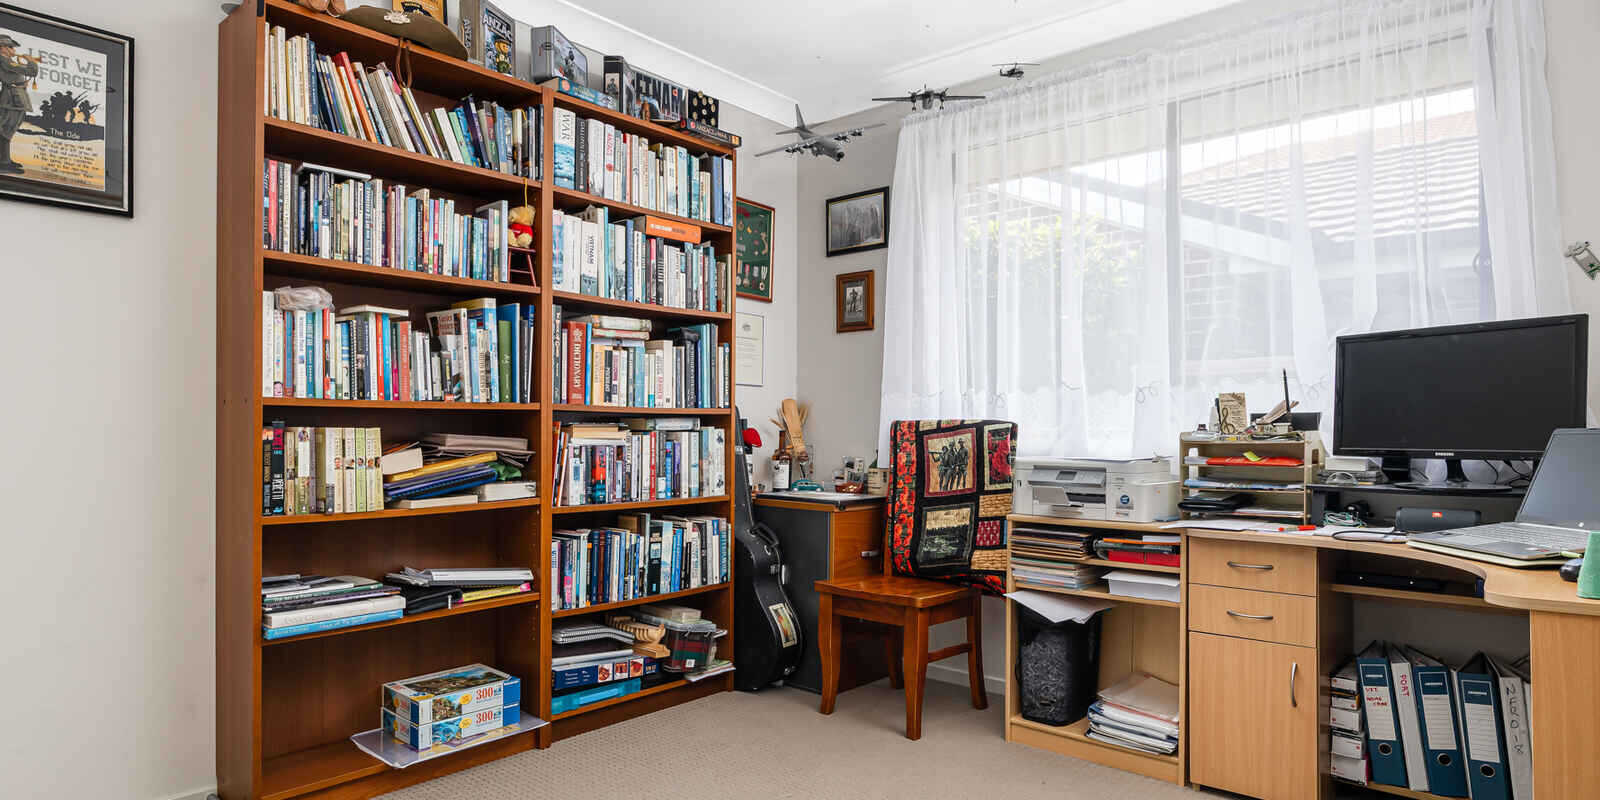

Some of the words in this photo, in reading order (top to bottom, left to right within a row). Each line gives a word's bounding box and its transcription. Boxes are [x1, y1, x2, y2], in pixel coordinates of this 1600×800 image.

[483, 14, 512, 41] ANZAC
[39, 66, 102, 93] FORGET
[76, 59, 102, 77] WE
[561, 114, 571, 141] WAR
[573, 343, 582, 388] DICTIONARY
[476, 687, 493, 701] 300
[1400, 674, 1410, 696] PORT
[476, 710, 493, 724] 300
